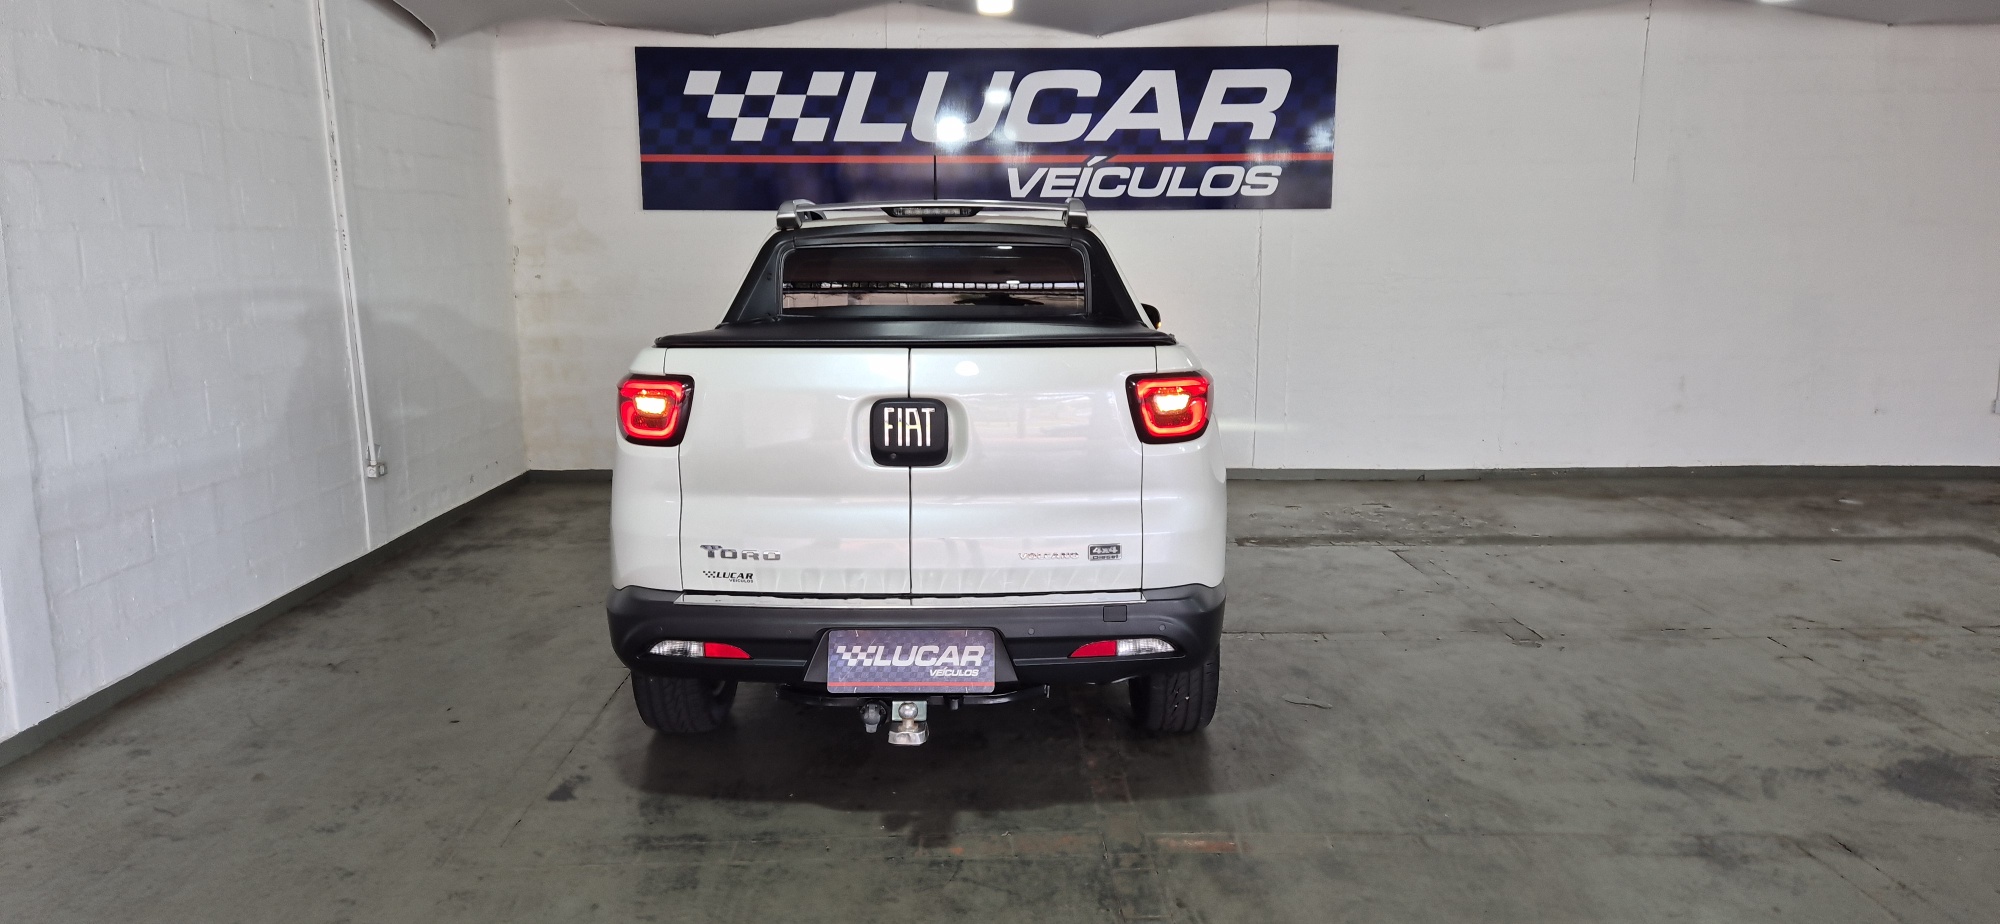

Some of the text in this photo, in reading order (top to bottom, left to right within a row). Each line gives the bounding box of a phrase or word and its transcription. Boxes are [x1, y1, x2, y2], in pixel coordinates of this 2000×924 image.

[834, 68, 1293, 142] LUCAR
[1007, 156, 1282, 198] VEÍCULOS
[883, 407, 936, 447] FIAT
[700, 545, 780, 560] TORO
[716, 571, 754, 580] LUCAR
[873, 645, 985, 666] LUCAR
[929, 666, 979, 677] VEÍCULOS
